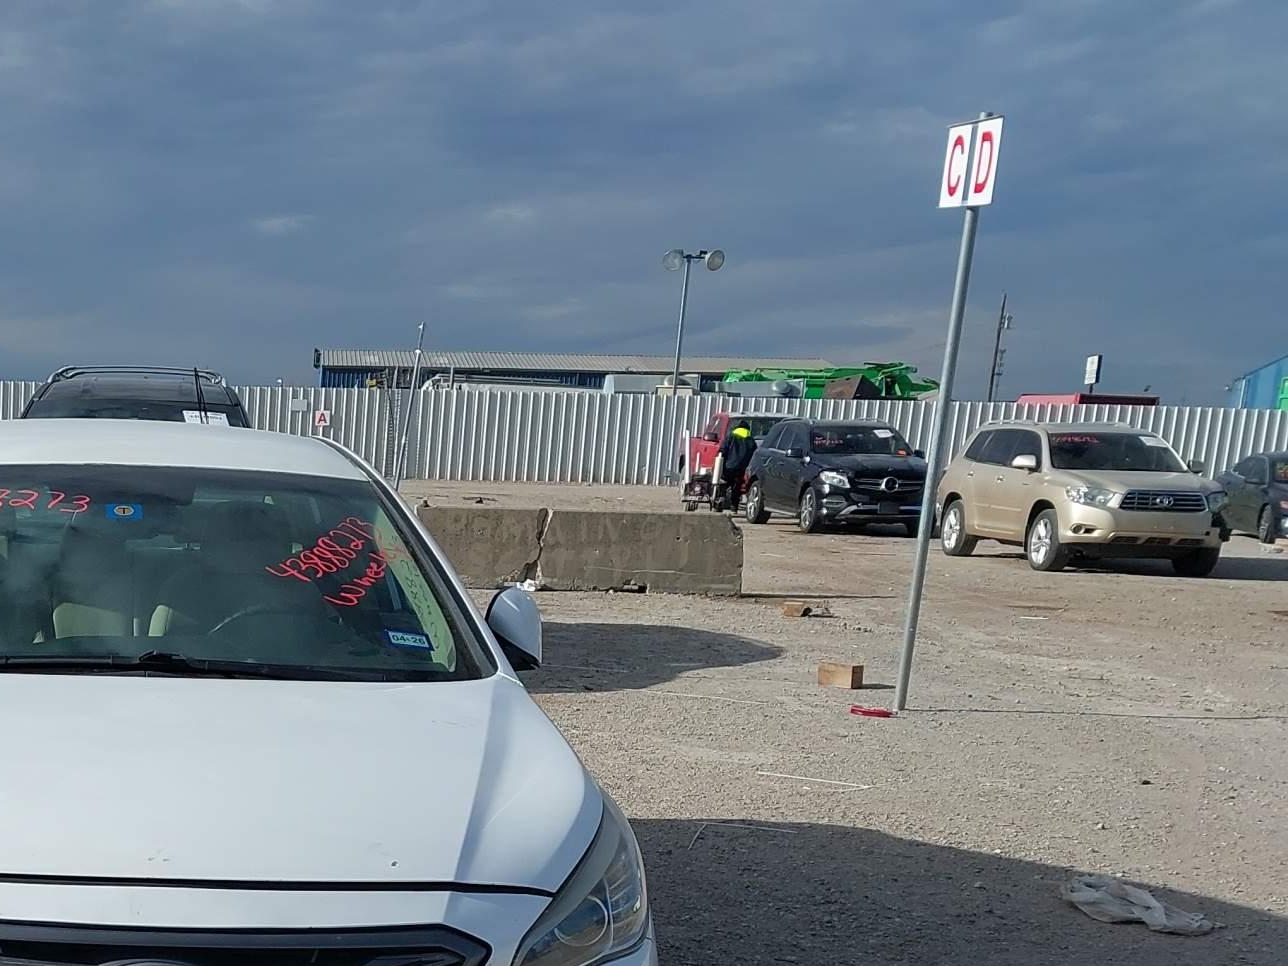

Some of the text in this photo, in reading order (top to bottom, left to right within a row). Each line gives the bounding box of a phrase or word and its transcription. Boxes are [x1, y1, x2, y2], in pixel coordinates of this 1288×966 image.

[948, 131, 993, 197] C D
[316, 412, 328, 425] A
